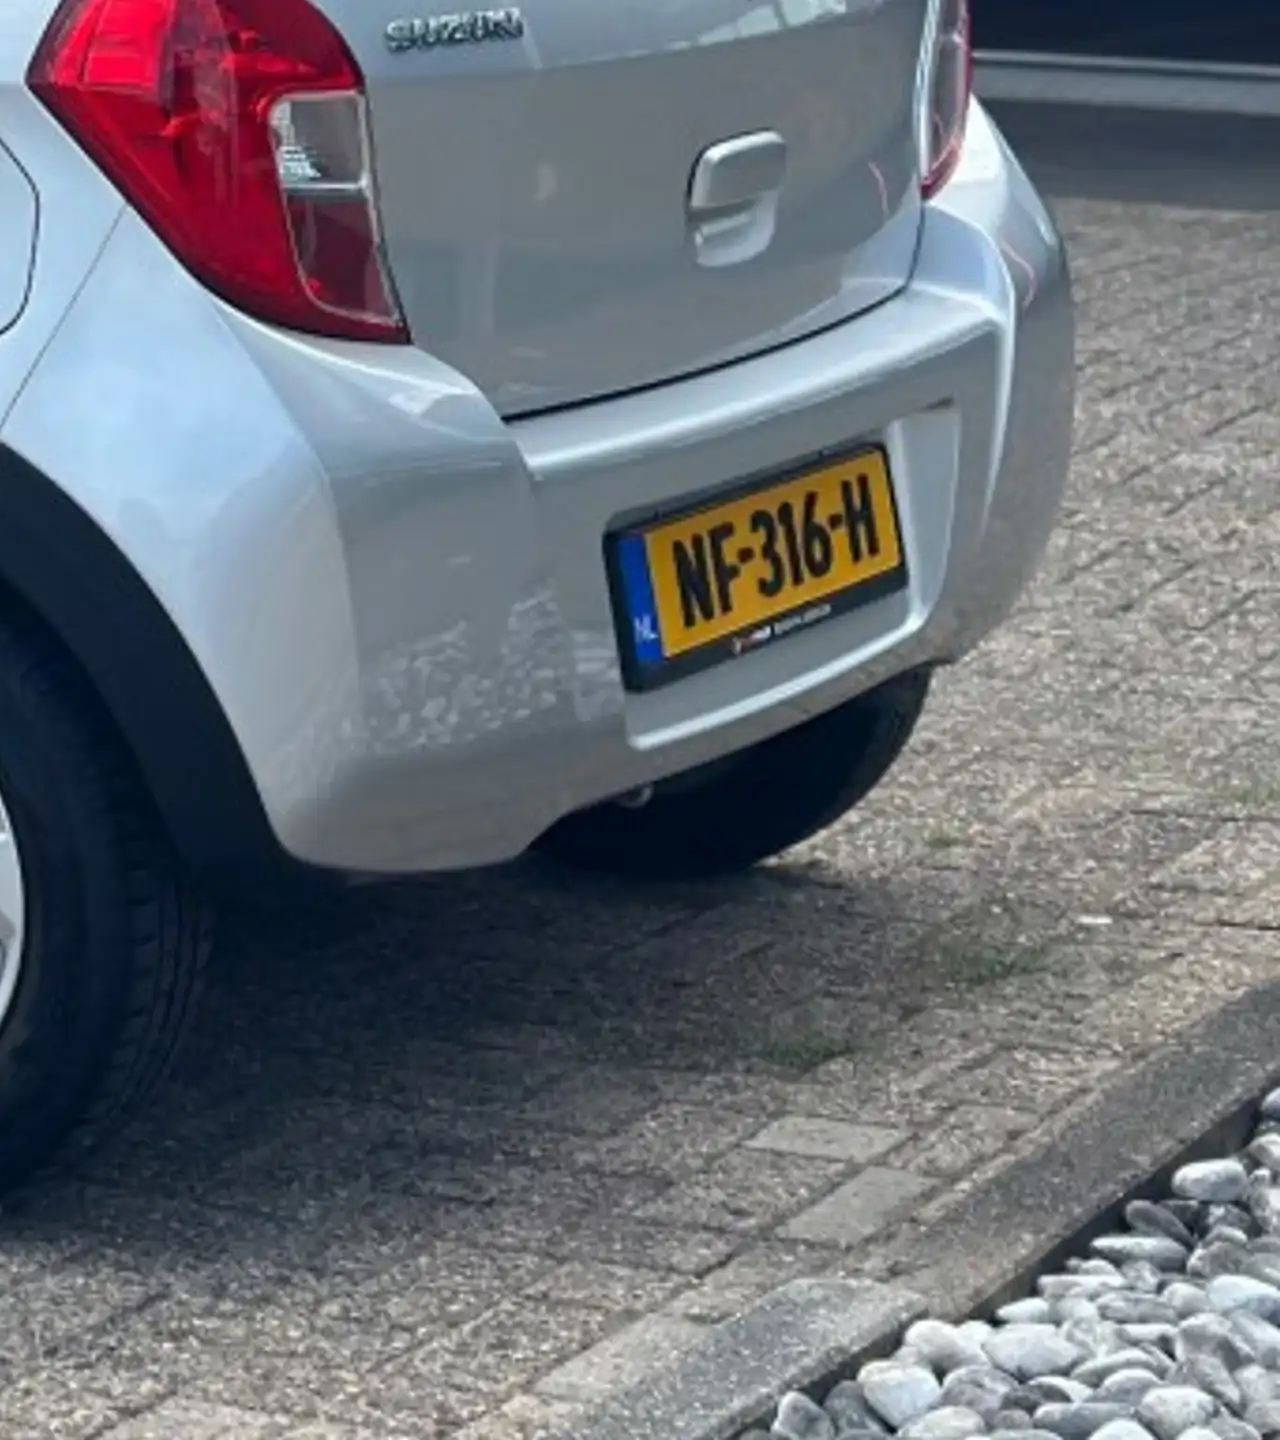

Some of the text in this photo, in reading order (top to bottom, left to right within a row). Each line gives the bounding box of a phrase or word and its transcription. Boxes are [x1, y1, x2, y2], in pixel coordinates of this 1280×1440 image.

[384, 7, 524, 54] SUZUKI
[672, 472, 881, 629] NF-316-H
[634, 615, 659, 643] NL
